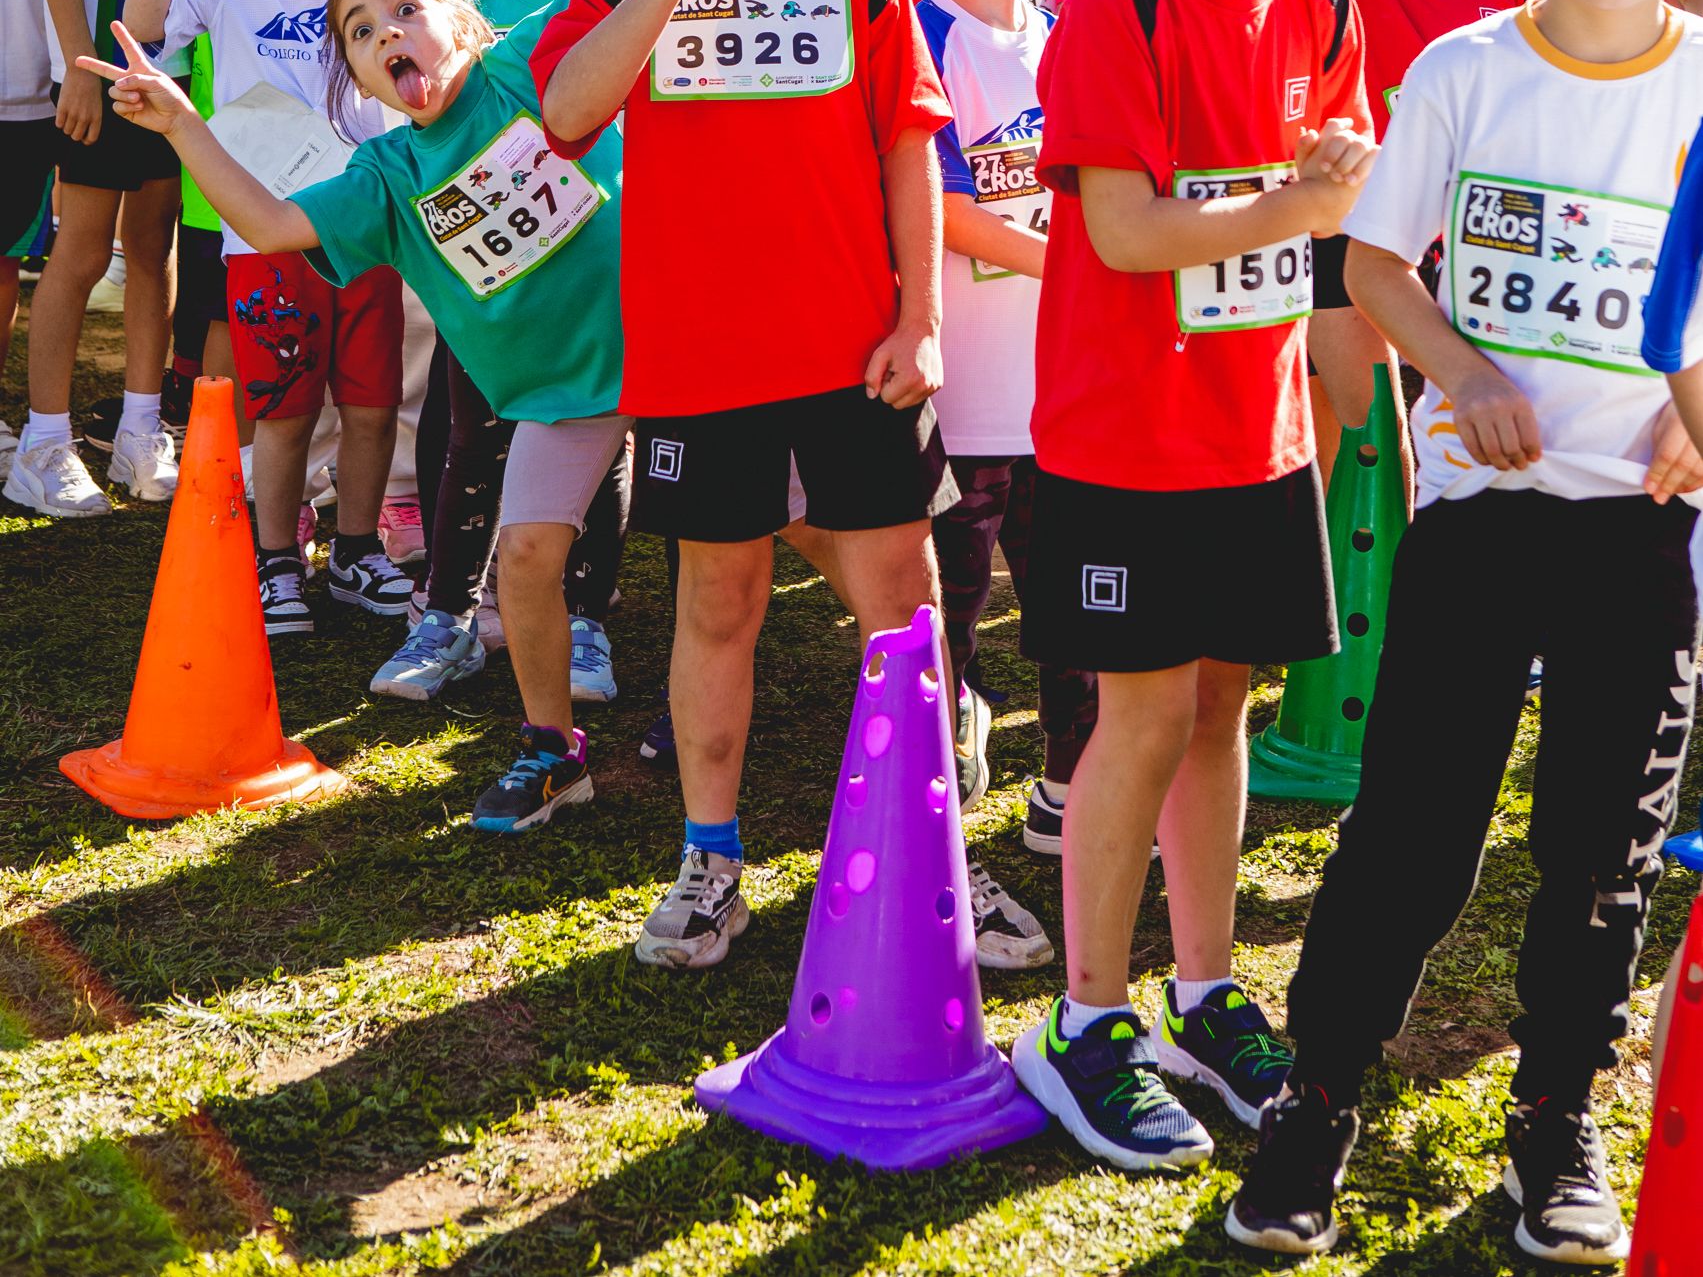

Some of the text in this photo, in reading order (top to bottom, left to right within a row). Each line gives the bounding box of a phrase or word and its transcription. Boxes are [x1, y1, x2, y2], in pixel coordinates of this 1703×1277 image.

[688, 11, 697, 19] de
[698, 10, 714, 18] Sant
[714, 9, 734, 18] Cugat
[676, 31, 820, 69] 3926
[975, 165, 1038, 194] CROS
[978, 185, 1041, 202] Ciutat de Sant Cugat
[429, 199, 476, 236] CROS
[461, 181, 559, 268] 1687
[1466, 212, 1539, 245] CROS
[1468, 266, 1631, 330] 2840
